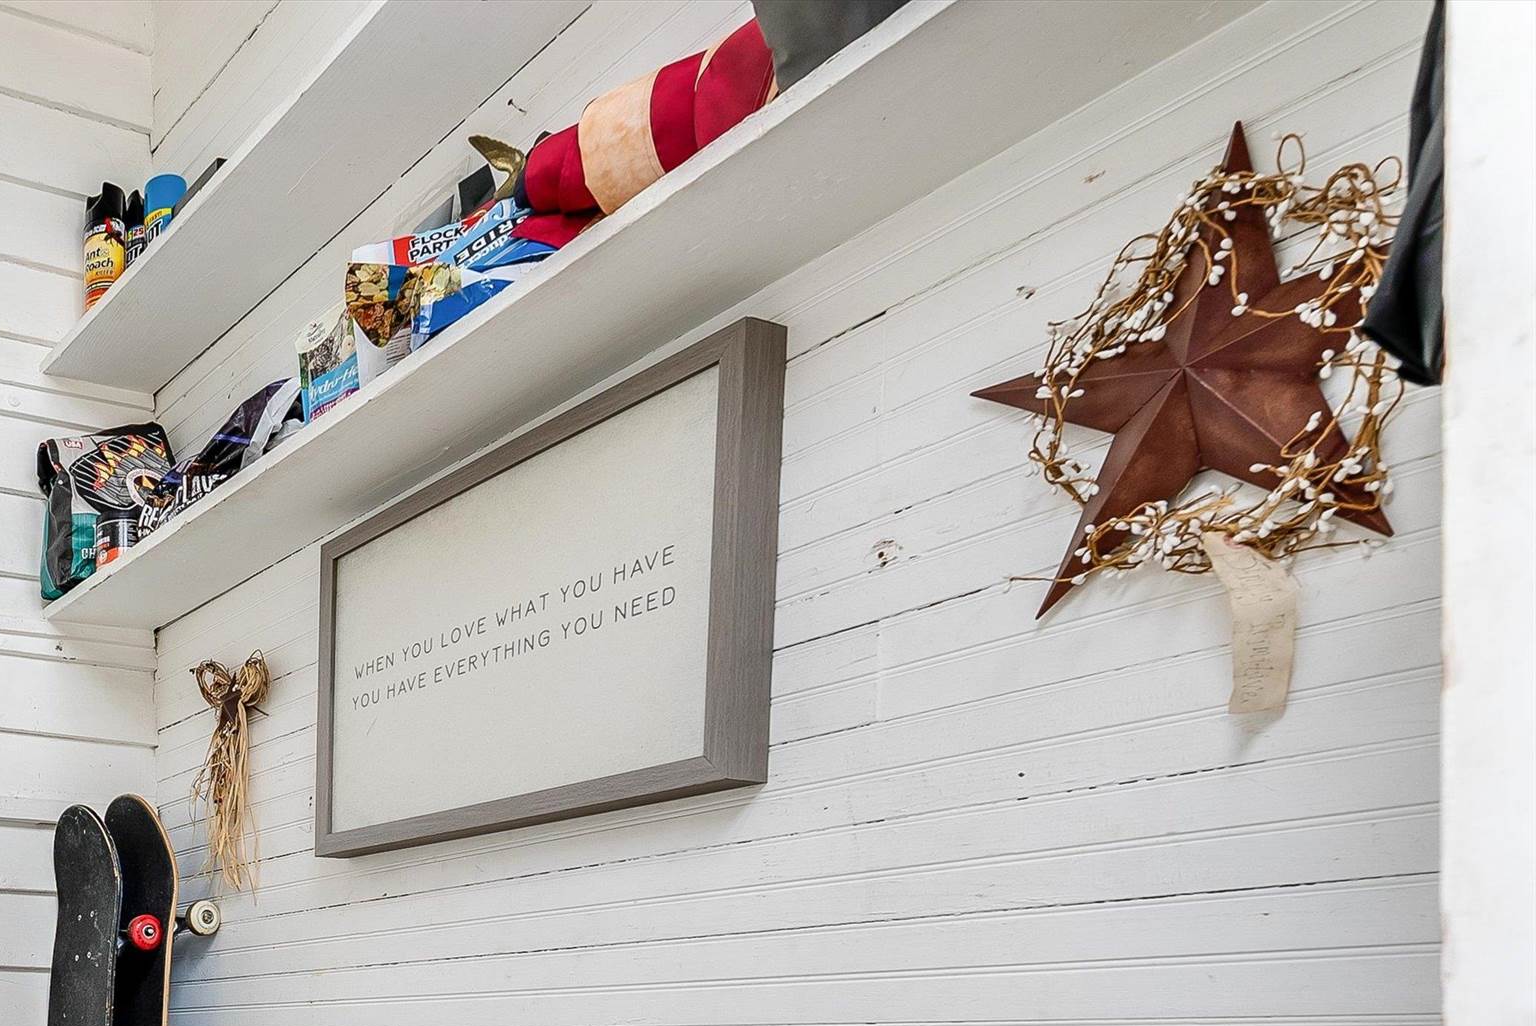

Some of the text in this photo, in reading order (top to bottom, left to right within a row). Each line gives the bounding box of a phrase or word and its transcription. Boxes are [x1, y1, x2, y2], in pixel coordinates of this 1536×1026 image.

[410, 227, 463, 249] FLOCK
[409, 239, 456, 261] PART
[65, 441, 82, 449] USA
[354, 544, 675, 680] WHEN YOU LOVE WHAT YOU HAVE
[352, 586, 676, 710] YOU HAVE EVERYTHING YOU NEED
